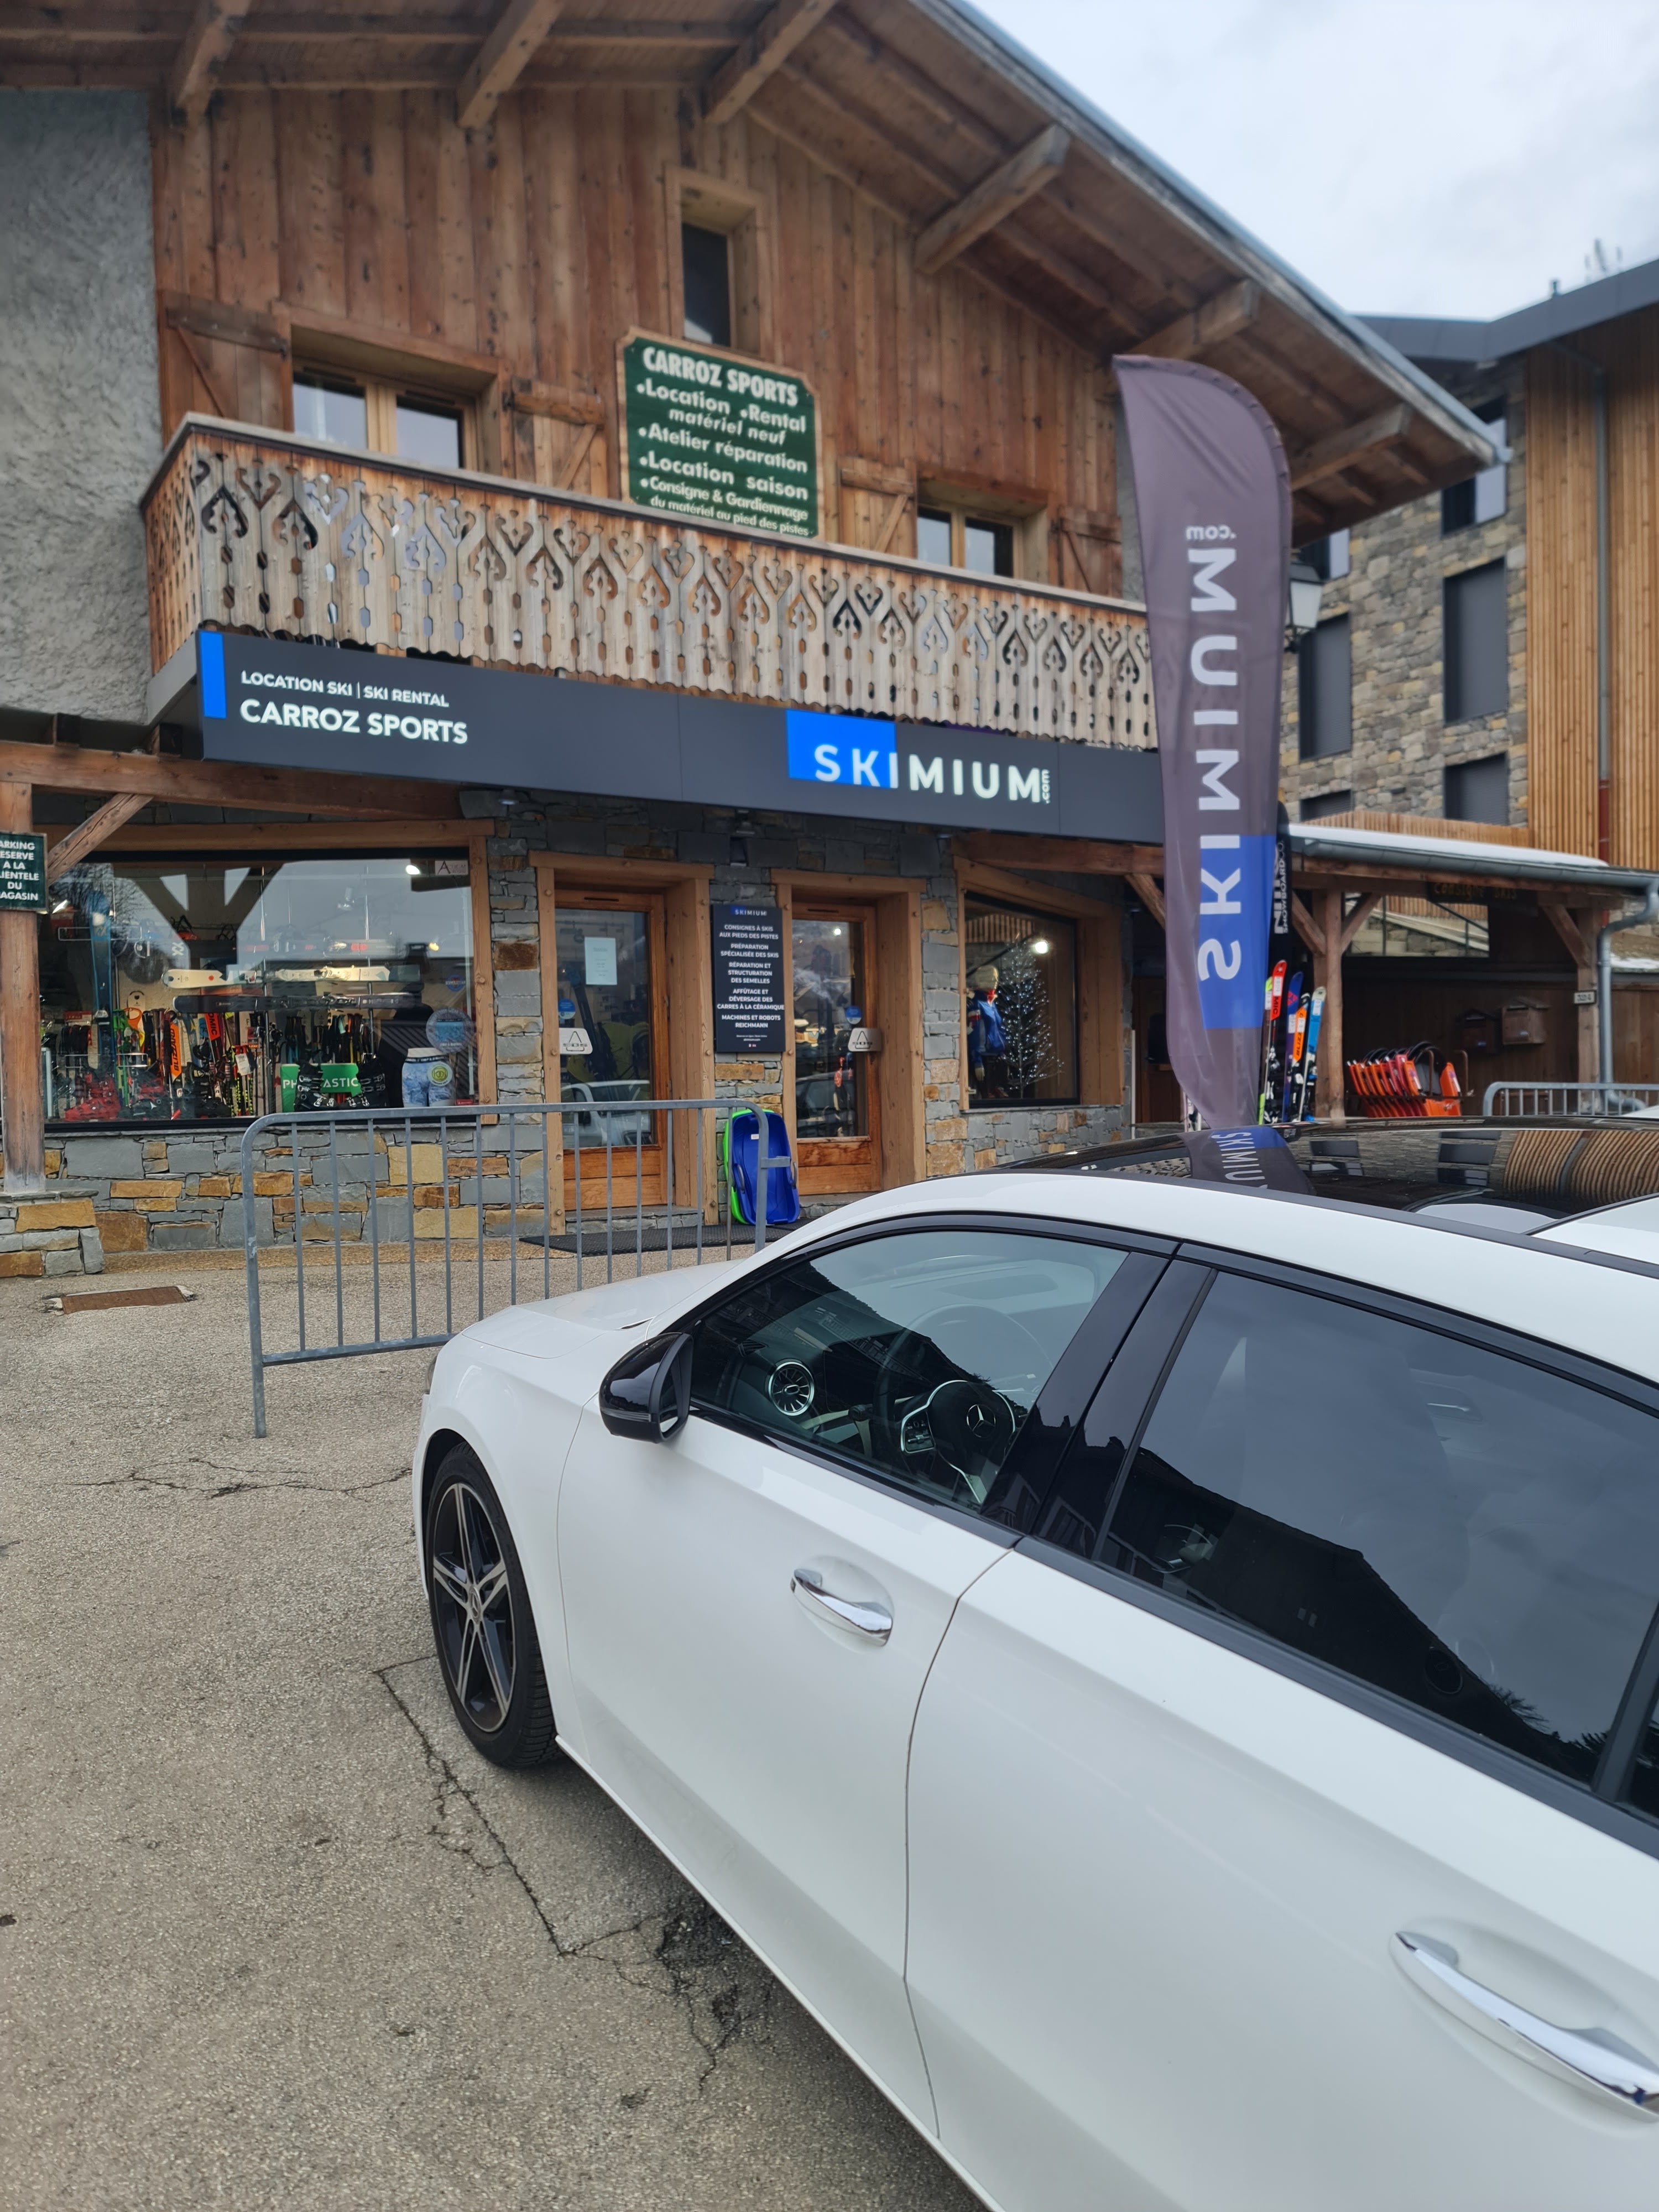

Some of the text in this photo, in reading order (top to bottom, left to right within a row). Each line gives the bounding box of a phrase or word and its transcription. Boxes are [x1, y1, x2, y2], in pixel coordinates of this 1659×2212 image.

[643, 346, 799, 408] CARROZ SPORTS
[645, 378, 730, 415] Location
[669, 408, 786, 446] matériel neuf
[748, 403, 806, 433] Rental
[648, 422, 808, 473] Atelier réparation
[648, 450, 808, 500] Location saison
[649, 475, 808, 522] Consigne & Gardiennage
[650, 495, 810, 536] du matériel au pied des pistes
[240, 670, 324, 693] LOCATION
[326, 681, 353, 697] SKI
[363, 685, 389, 701] SKI
[391, 688, 450, 708] RENTAL
[239, 698, 469, 745] CARROZ SPORTS
[813, 744, 1040, 804] SKIMIUM
[1041, 769, 1051, 804] .com
[0, 840, 35, 851] ARKING
[0, 851, 34, 860] ESERVE
[0, 871, 39, 881] IENTELE
[3, 860, 25, 870] A LA
[0, 891, 39, 901] AGASIN
[7, 881, 22, 890] DU
[207, 1013, 217, 1036] OMIC
